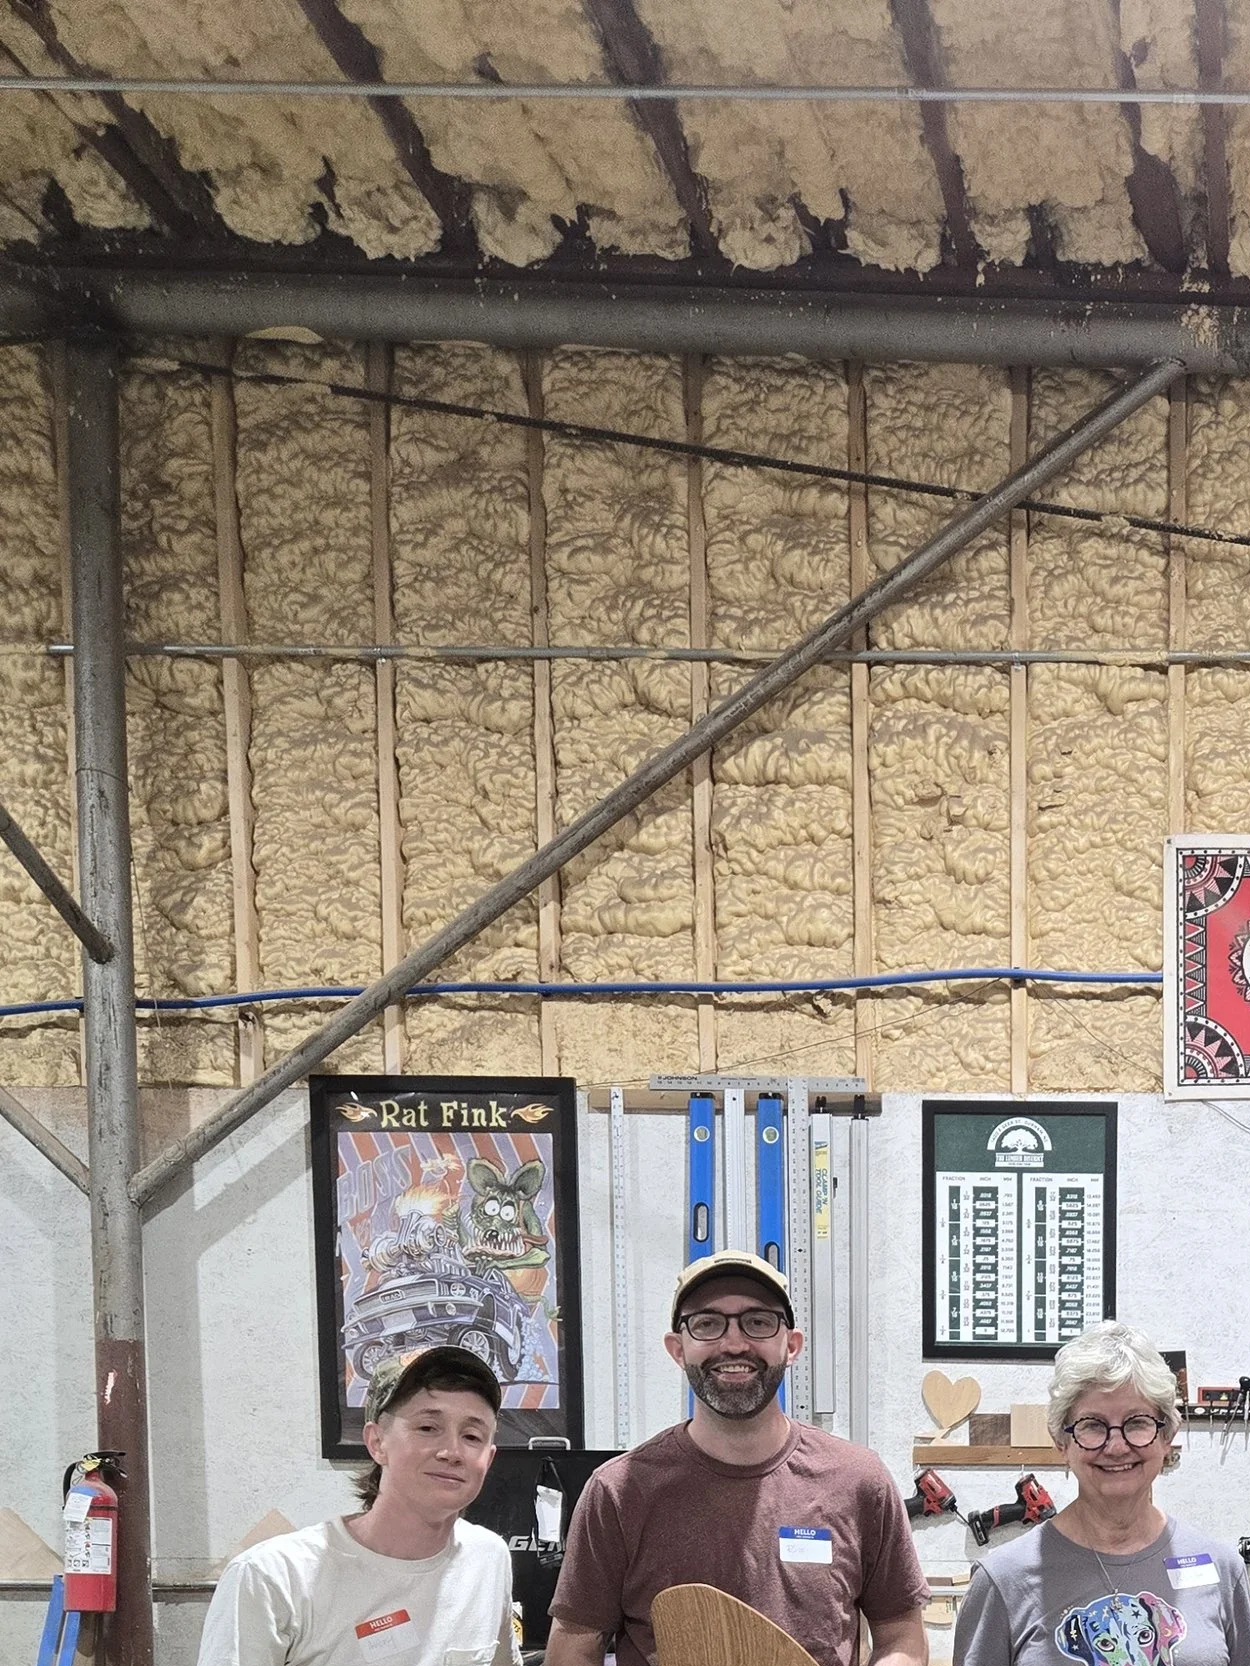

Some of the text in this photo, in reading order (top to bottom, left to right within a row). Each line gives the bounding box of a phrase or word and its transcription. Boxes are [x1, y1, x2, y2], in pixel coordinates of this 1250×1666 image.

[380, 1100, 508, 1128] Rat Fink
[794, 1528, 816, 1536] HELLO
[1177, 1557, 1197, 1565] HELLO
[369, 1616, 393, 1629] HELLO
